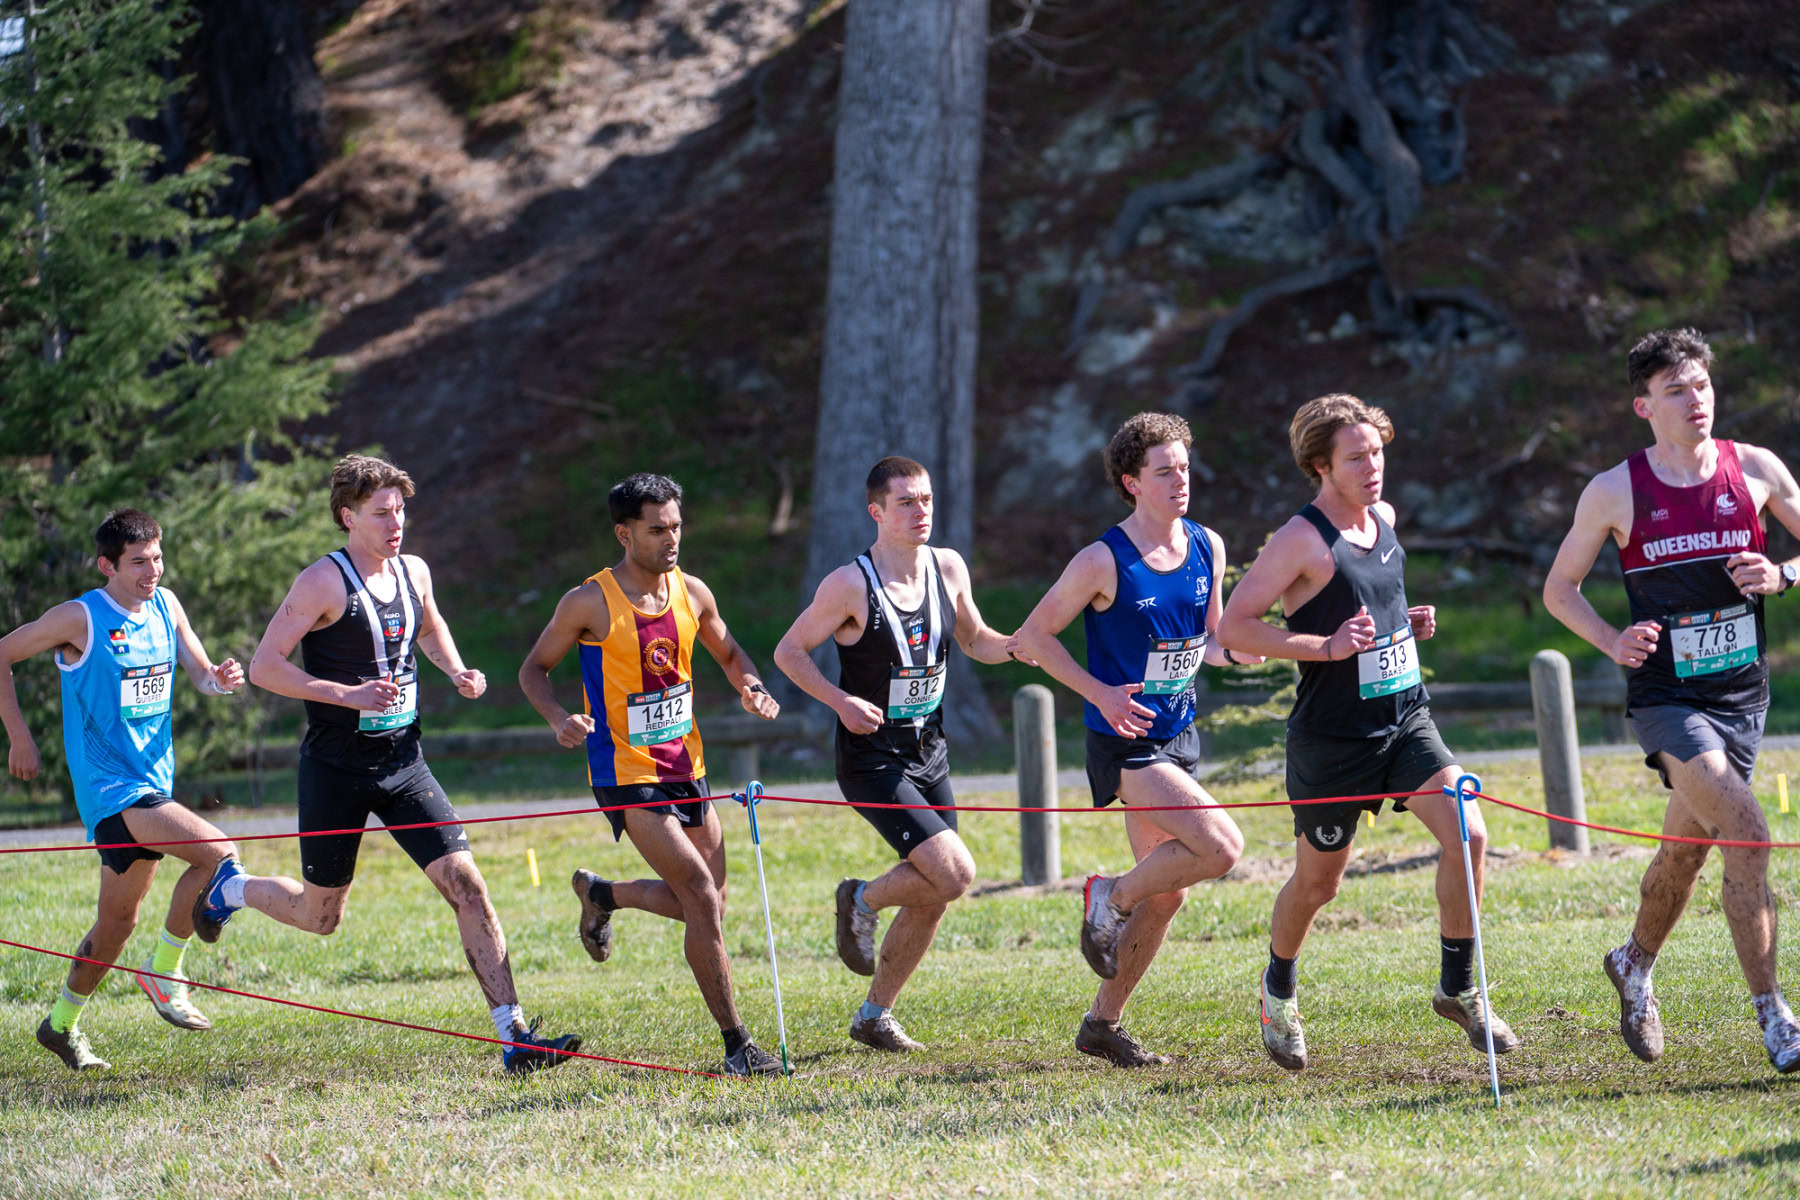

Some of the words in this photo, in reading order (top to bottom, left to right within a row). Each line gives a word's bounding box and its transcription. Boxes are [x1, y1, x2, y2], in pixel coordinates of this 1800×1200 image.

[1642, 529, 1752, 562] QUEENSLAND
[1693, 622, 1737, 649] 778
[1161, 649, 1199, 672] 1560
[1379, 644, 1407, 671] 513
[1696, 641, 1738, 658] TALLON
[132, 676, 165, 697] 1569
[908, 676, 940, 697] 812
[382, 705, 403, 716] GILES
[641, 697, 683, 724] 1412
